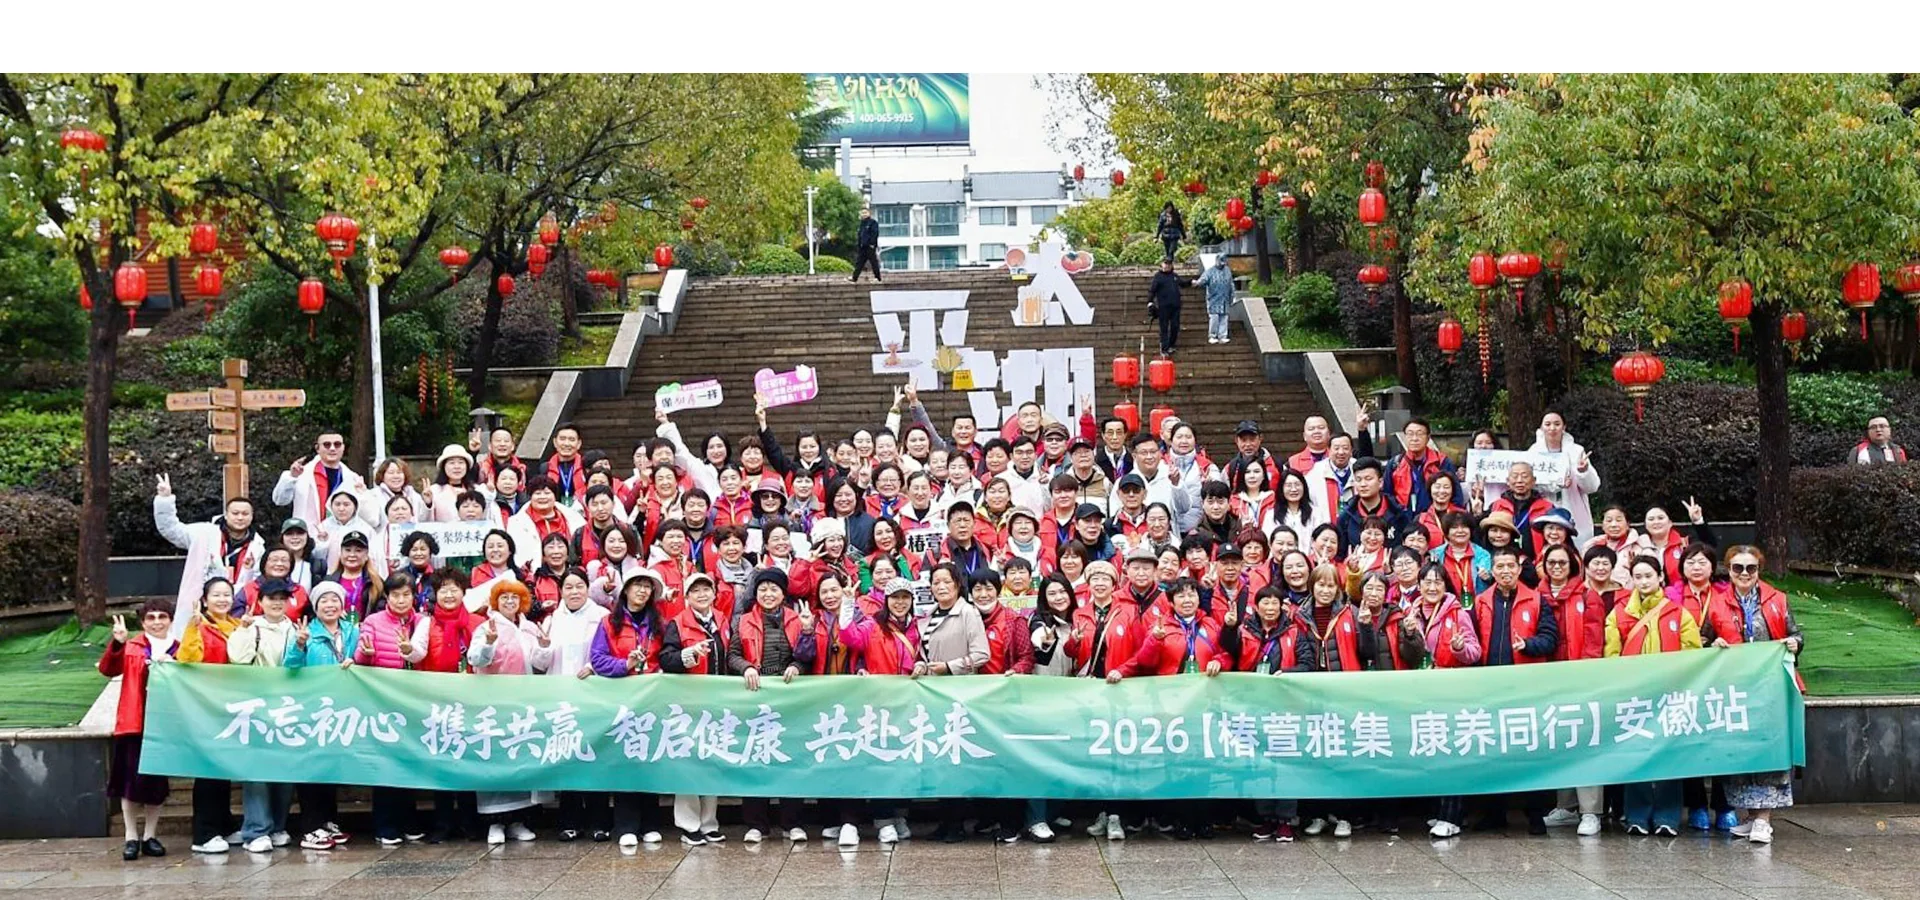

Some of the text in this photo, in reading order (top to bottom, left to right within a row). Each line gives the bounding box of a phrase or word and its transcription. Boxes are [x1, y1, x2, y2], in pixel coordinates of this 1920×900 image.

[216, 696, 407, 747] 不忘初心
[421, 700, 596, 765] 携手共赢
[605, 703, 792, 766] 智启健康
[805, 701, 996, 765] 共赴未来
